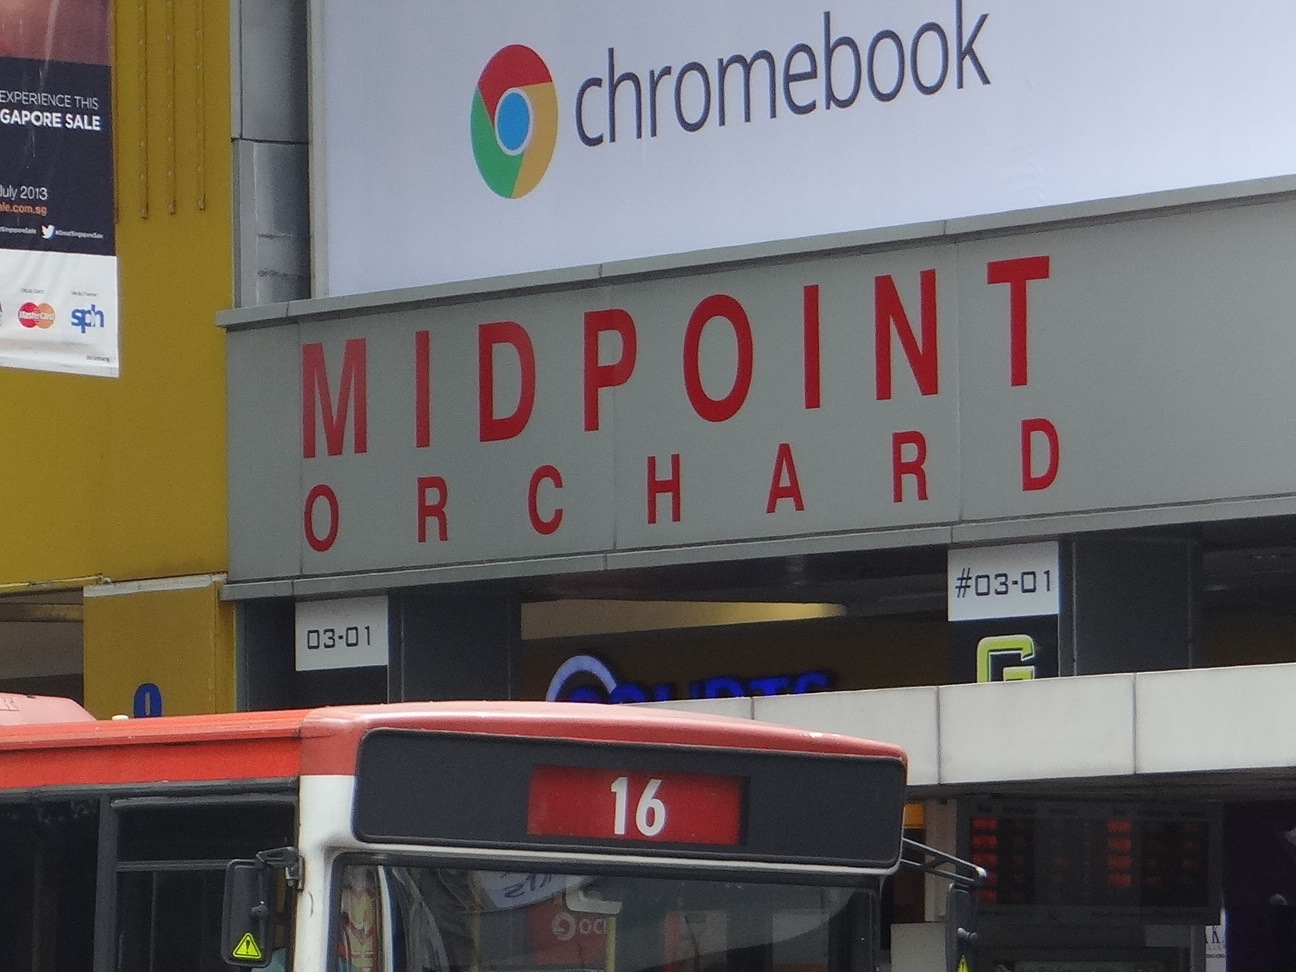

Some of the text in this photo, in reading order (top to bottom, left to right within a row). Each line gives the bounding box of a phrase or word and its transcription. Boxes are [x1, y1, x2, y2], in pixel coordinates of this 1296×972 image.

[575, 0, 992, 147] chromebook
[74, 95, 100, 110] THIS
[65, 113, 101, 131] SALE
[20, 186, 48, 201] 2013
[303, 255, 1050, 458] MIDPOINT
[304, 417, 1060, 552] ORCHARD
[955, 567, 1051, 598] #03-01
[307, 626, 371, 649] 03-01
[610, 776, 666, 837] 16
